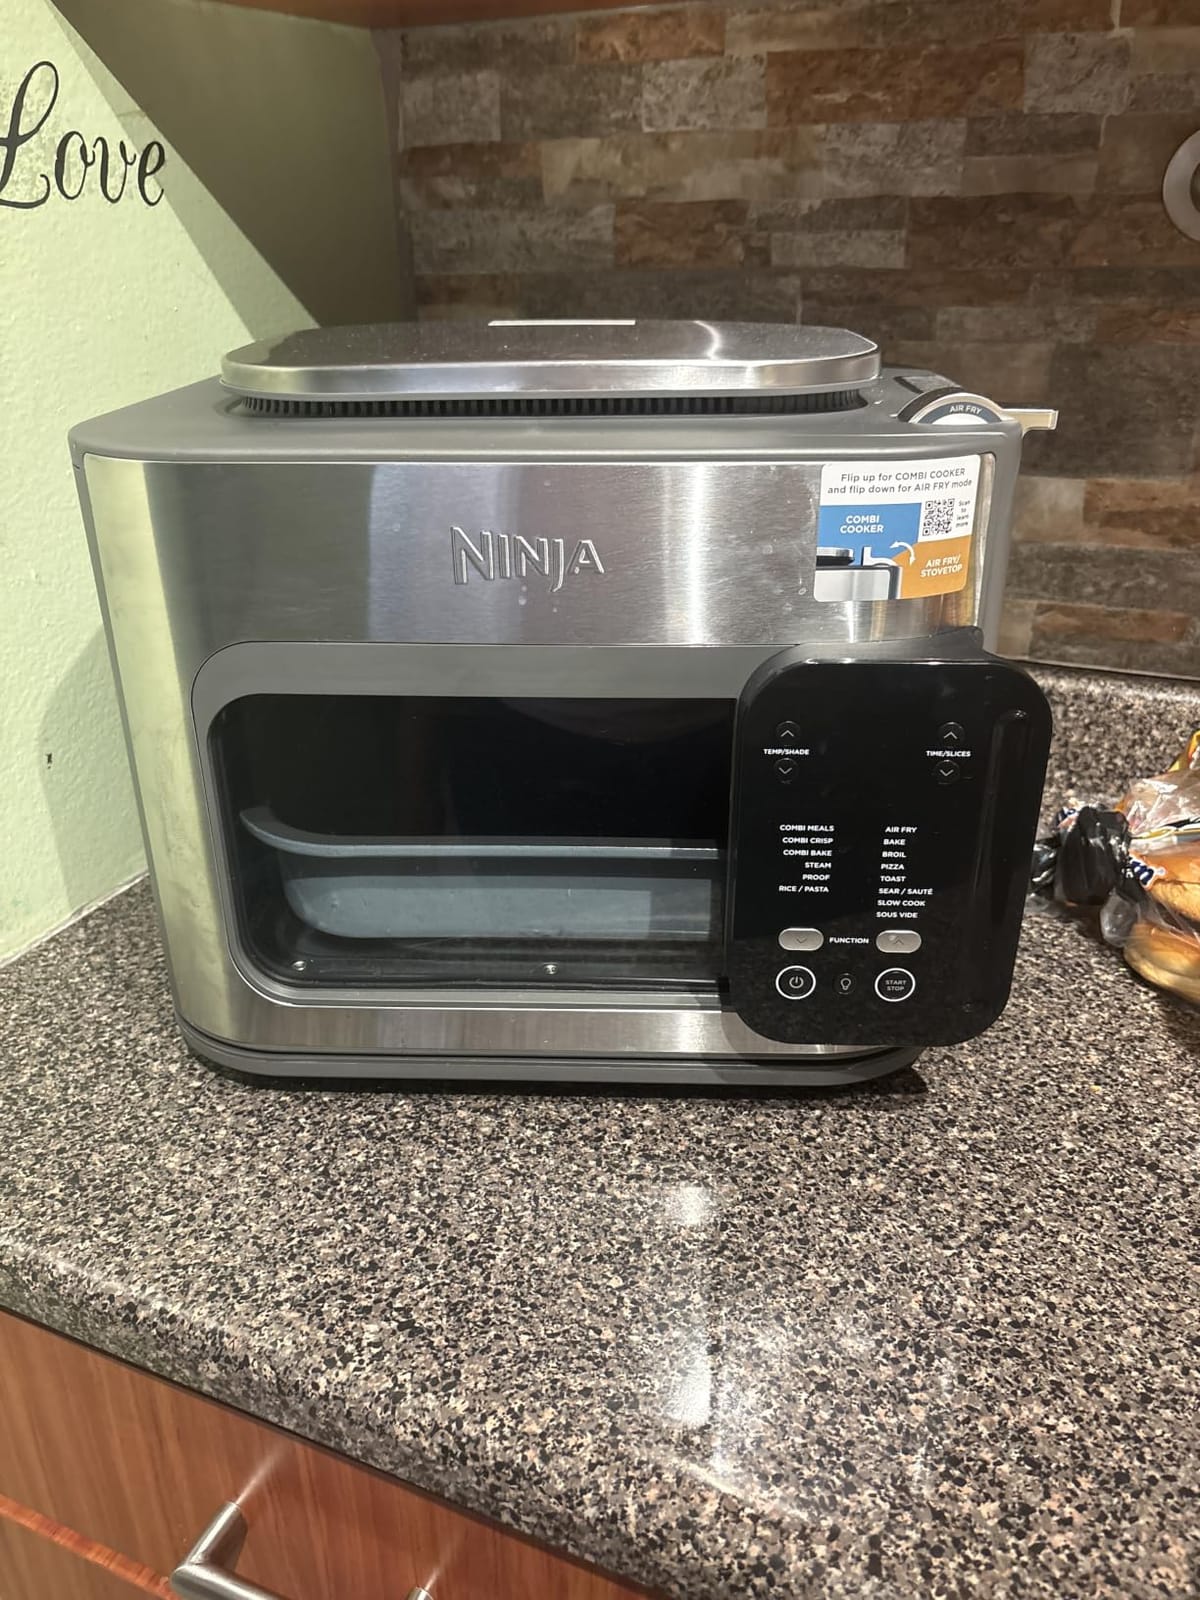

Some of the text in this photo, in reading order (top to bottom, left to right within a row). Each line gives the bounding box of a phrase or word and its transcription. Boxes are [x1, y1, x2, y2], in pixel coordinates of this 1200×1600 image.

[0, 61, 165, 209] Love
[950, 405, 982, 414] AIR FRY
[841, 468, 965, 483] Flip up for COMBI COOKER
[828, 479, 972, 495] and flip down for AIR FRY mode
[846, 515, 880, 524] COMBI
[840, 524, 884, 534] COOKER
[450, 526, 605, 592] NINJA
[925, 554, 961, 568] AIR FRY/
[920, 563, 963, 578] STOVETOP
[763, 748, 810, 756] TEMP/SHADE
[926, 750, 971, 758] TIME/SLICES
[780, 824, 835, 832] COMBI MEALS
[883, 838, 906, 846] BAKE
[810, 849, 832, 857] BAKE
[778, 885, 797, 893] RICE
[907, 887, 933, 895] SAUTÉ
[876, 911, 918, 919] SOUS VIDE
[829, 937, 869, 945] FUNCTION
